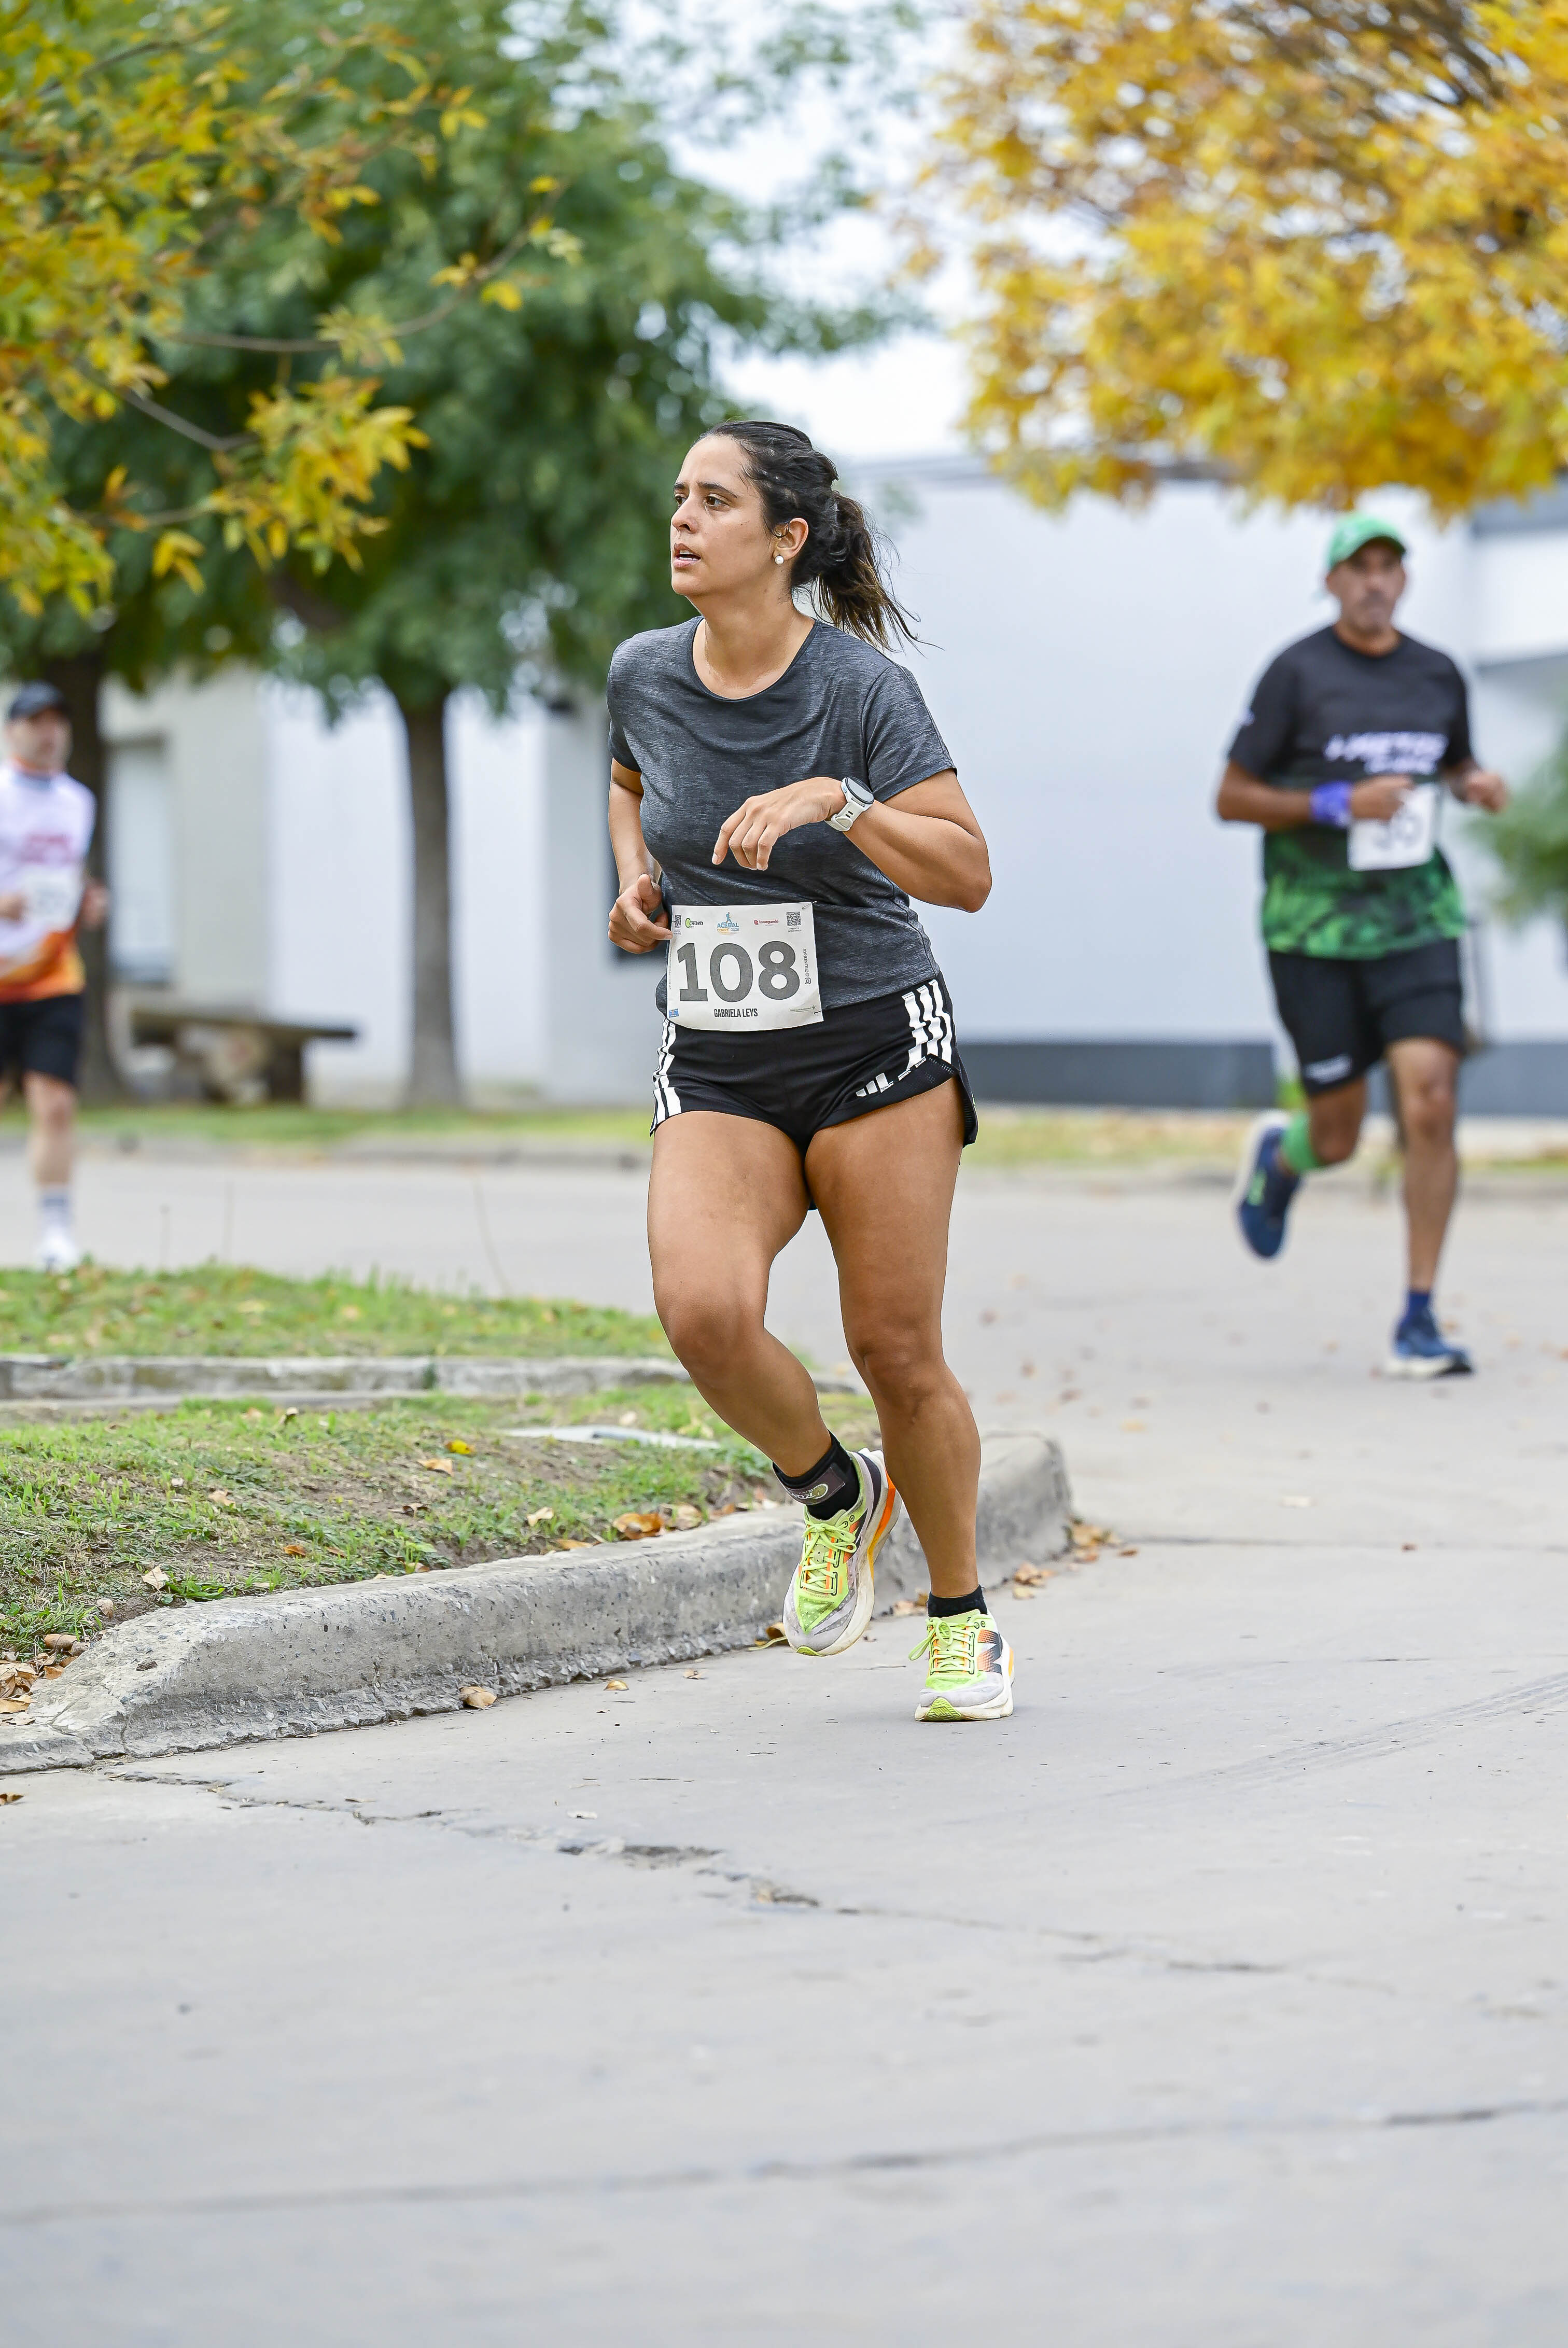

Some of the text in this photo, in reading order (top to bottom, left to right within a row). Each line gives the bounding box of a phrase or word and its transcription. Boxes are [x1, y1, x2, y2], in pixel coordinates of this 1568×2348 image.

[677, 941, 800, 1002] 108
[713, 1008, 758, 1017] GABRIELA LEYS
